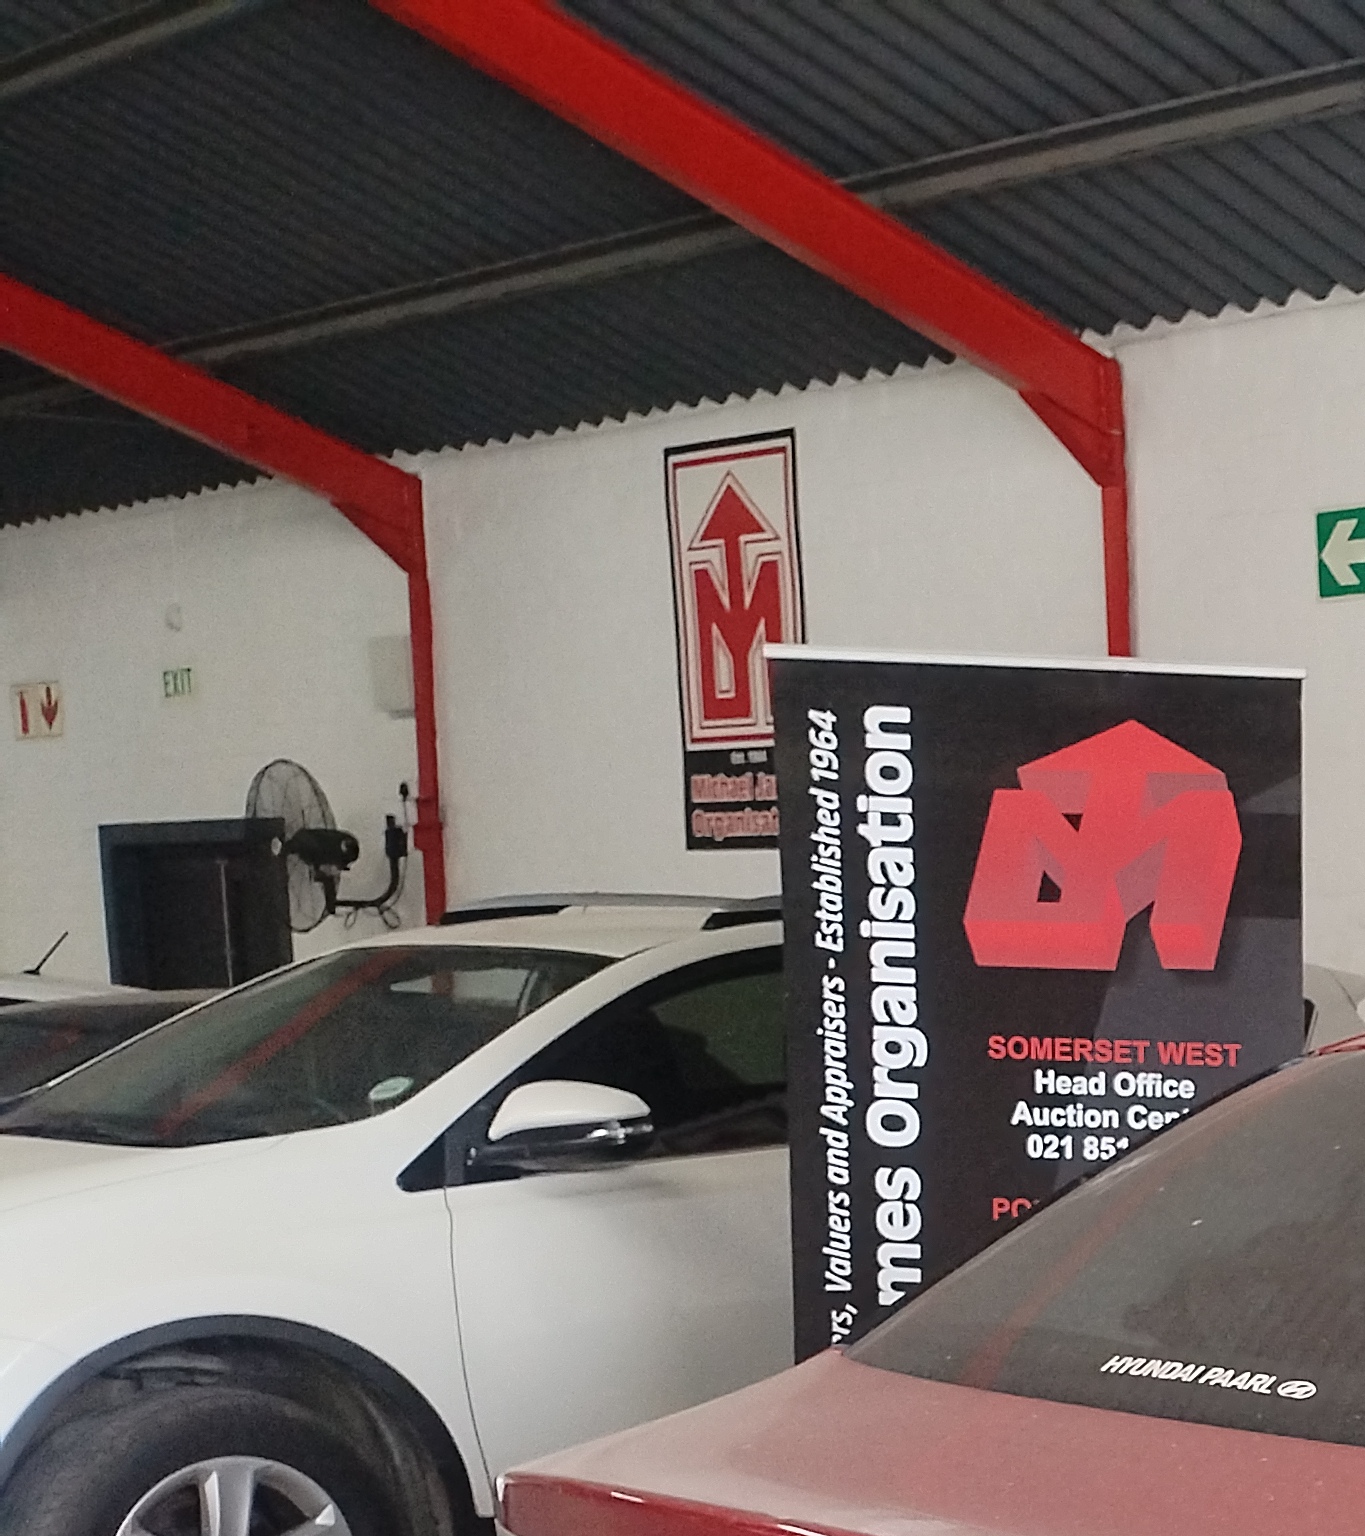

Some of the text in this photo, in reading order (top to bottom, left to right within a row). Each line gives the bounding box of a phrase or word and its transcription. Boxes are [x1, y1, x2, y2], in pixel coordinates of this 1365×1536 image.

[163, 668, 192, 698] EXIT
[808, 708, 839, 782] 1964
[808, 786, 844, 953] Established
[856, 704, 929, 1149] Organisation
[818, 974, 855, 1126] Appraisers
[987, 1035, 1242, 1068] SOMERSET WEST
[1033, 1068, 1197, 1099] Head Office
[1010, 1100, 1190, 1130] Auction Ce
[819, 1127, 850, 1186] and
[1026, 1133, 1073, 1160] 021
[822, 1189, 853, 1294] Valuers
[831, 1302, 858, 1344] rs,
[1101, 1355, 1277, 1395] HYUNDAI PAARL
